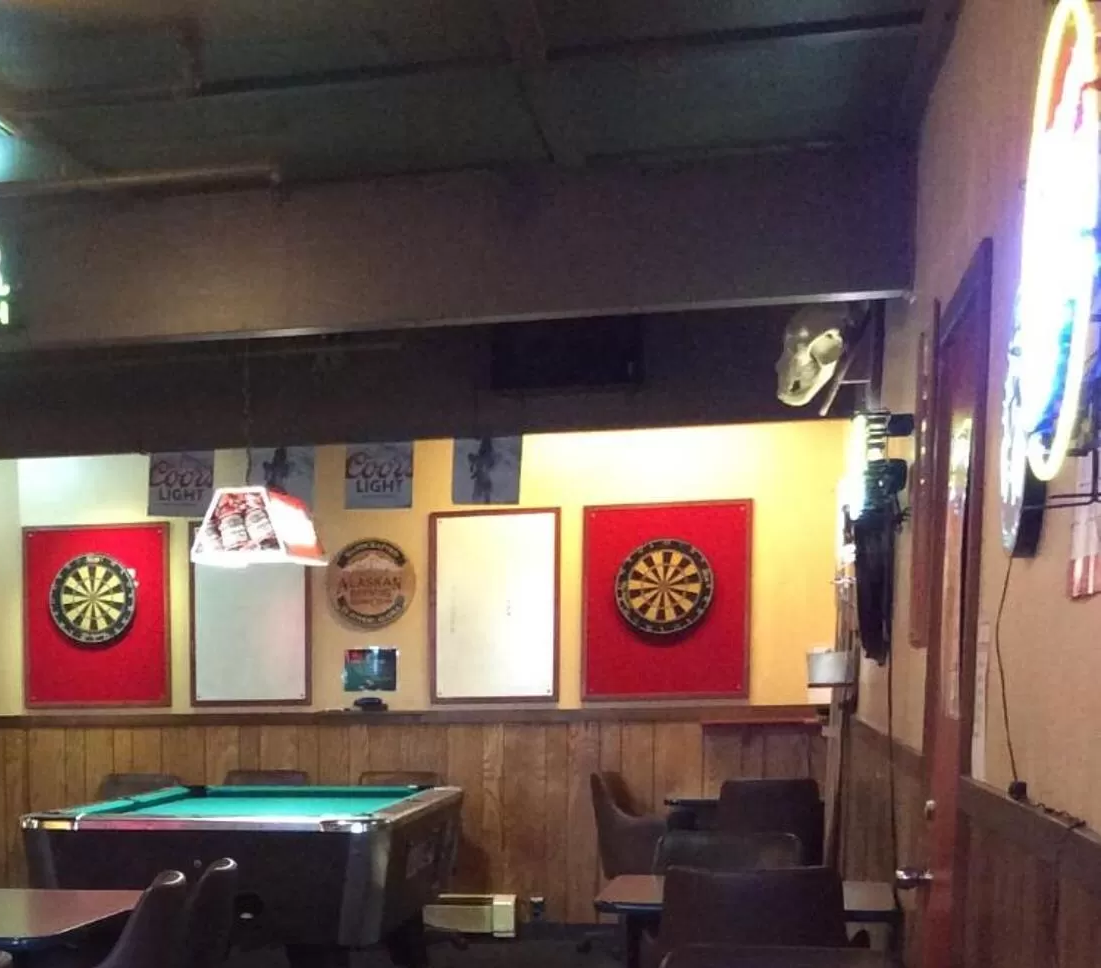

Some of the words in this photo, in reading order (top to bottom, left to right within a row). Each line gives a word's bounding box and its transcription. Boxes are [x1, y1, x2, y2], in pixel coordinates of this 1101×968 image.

[356, 479, 404, 493] LIGHT
[159, 488, 204, 501] LIGHT
[338, 576, 402, 592] ALASKAN
